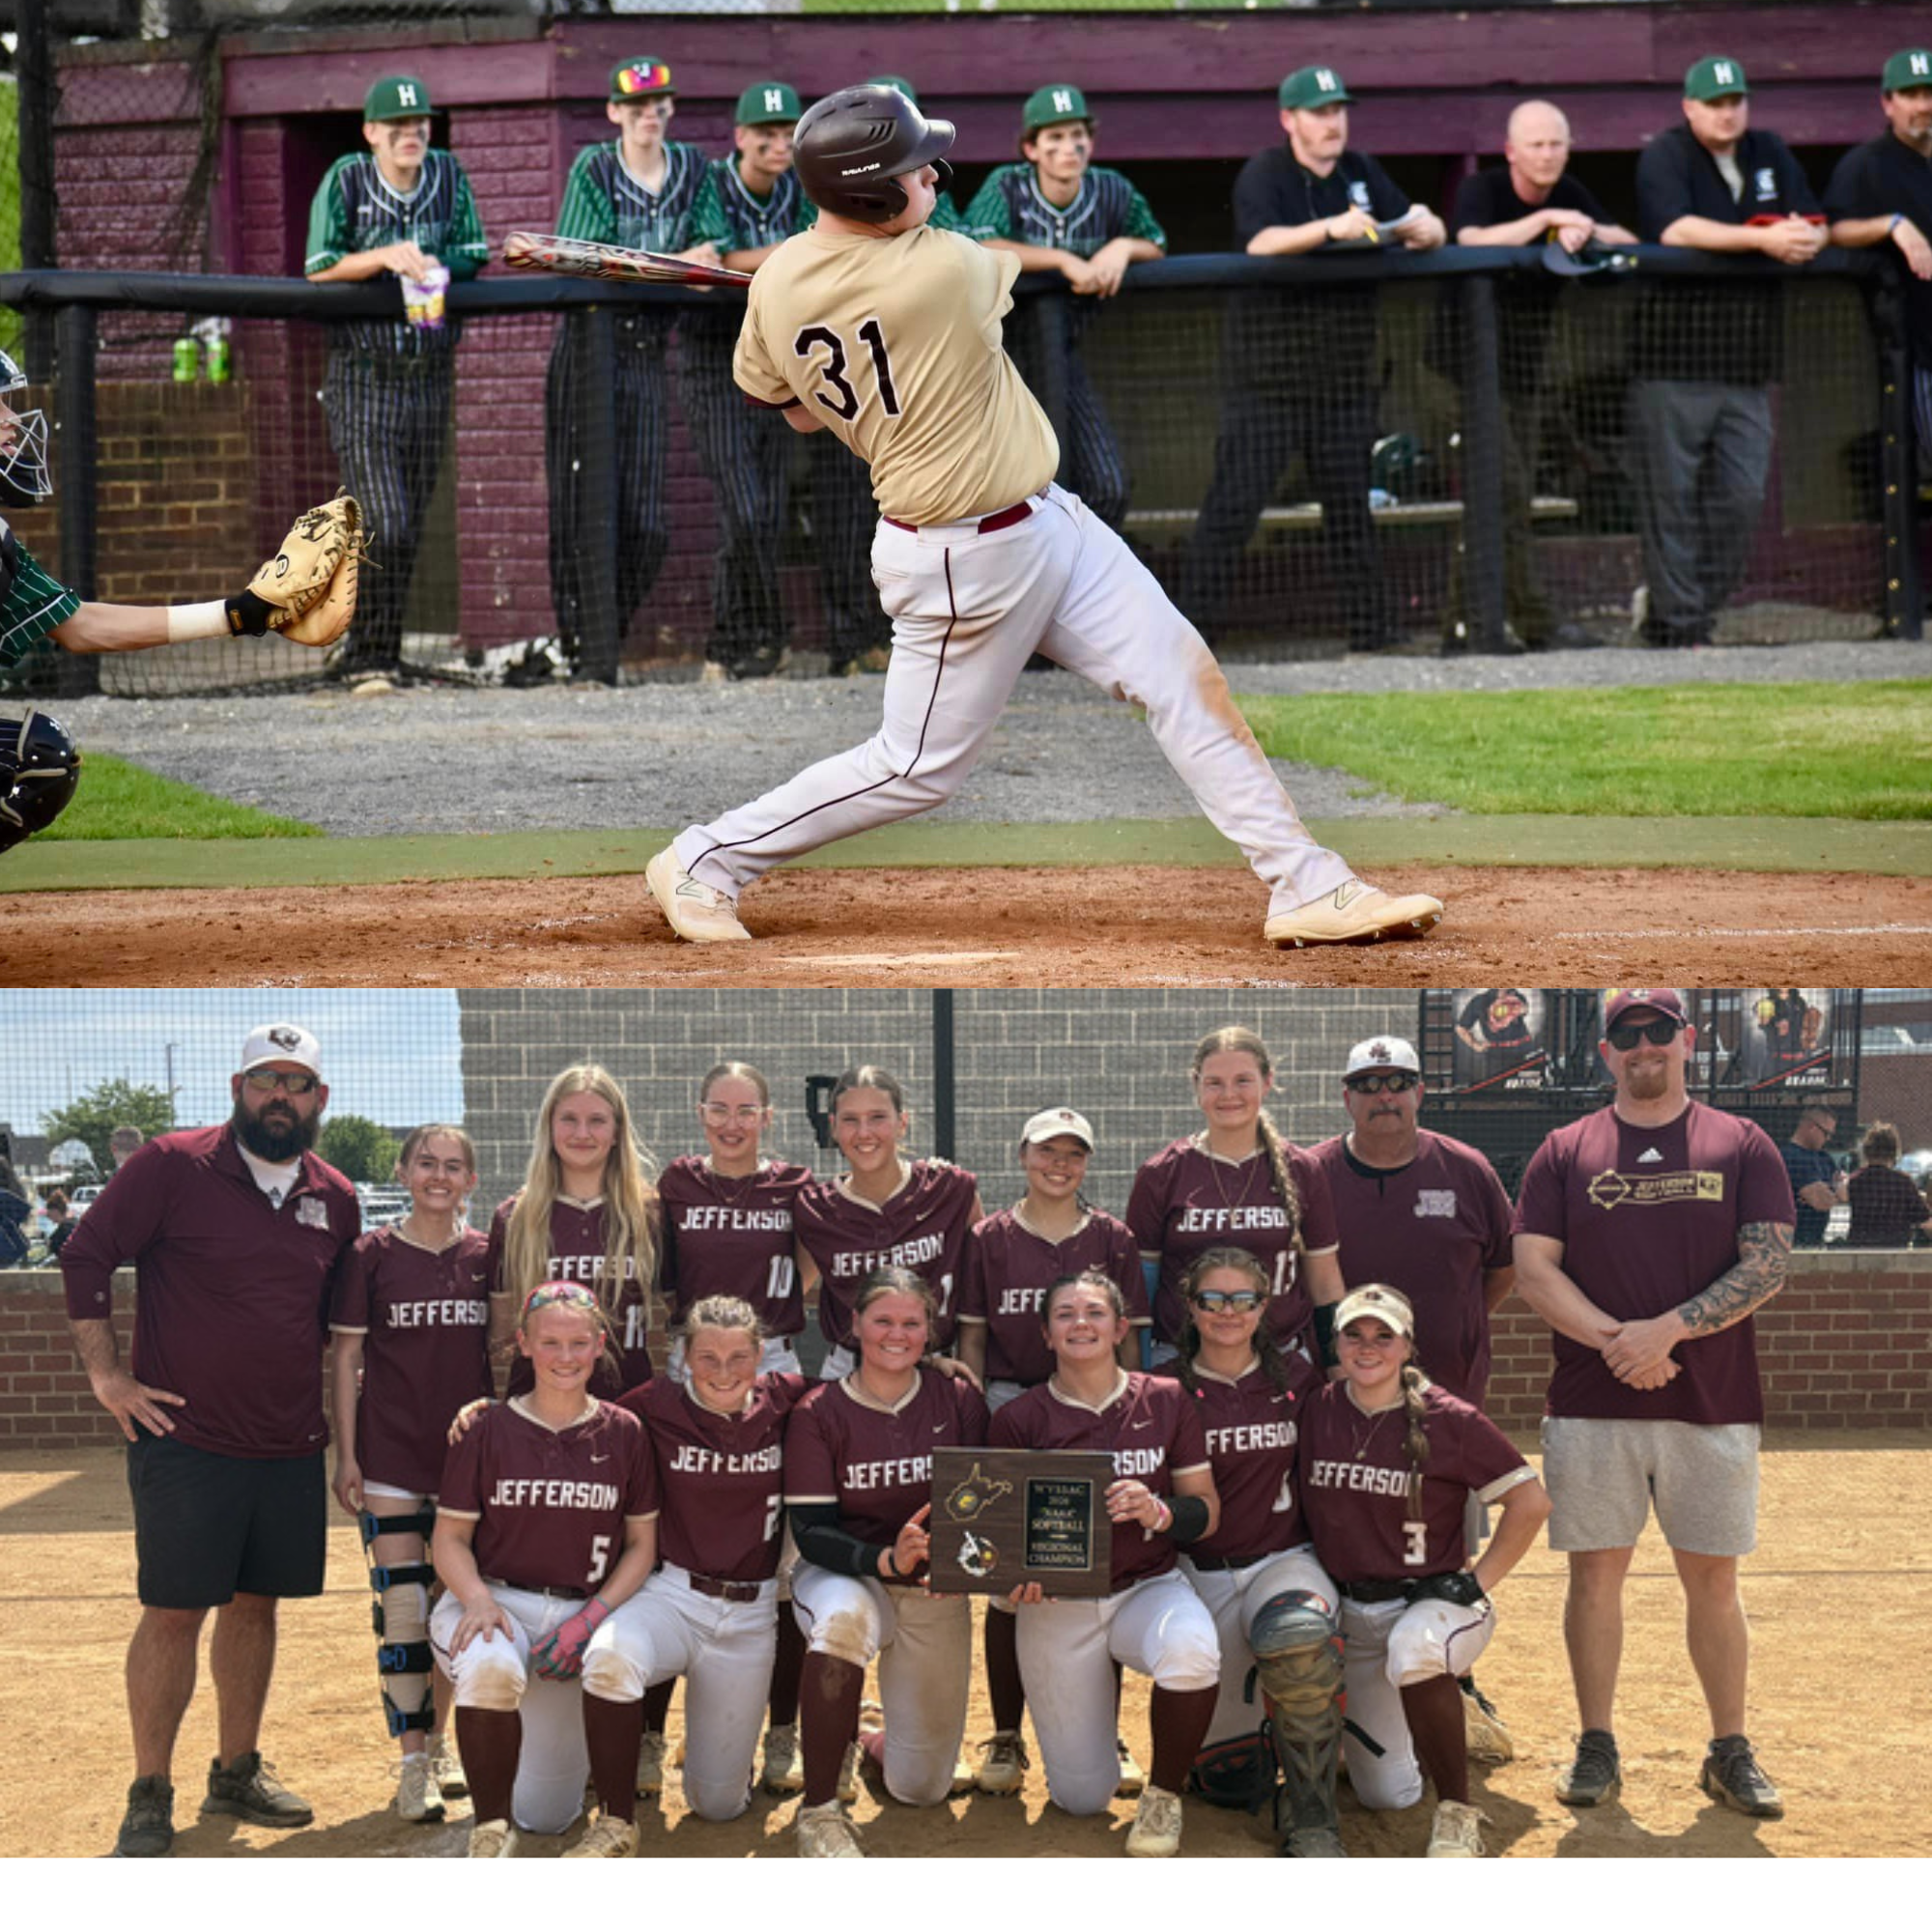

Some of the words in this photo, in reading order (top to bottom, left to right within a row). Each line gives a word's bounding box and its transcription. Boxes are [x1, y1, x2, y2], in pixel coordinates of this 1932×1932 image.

[1714, 62, 1734, 85] H
[1910, 52, 1929, 75] H
[1315, 69, 1337, 92] H
[398, 84, 416, 107] H
[763, 88, 782, 112] H
[1052, 90, 1072, 113] H
[793, 316, 902, 423] 31
[1177, 1207, 1290, 1232] JEFFERSO
[831, 1231, 946, 1277] JEFFERSON
[767, 1255, 794, 1298] 10
[387, 1299, 488, 1328] JEFFERSO
[670, 1445, 781, 1473] JEFFERSO
[490, 1479, 618, 1510] JEFFERSON
[1402, 1521, 1428, 1566] 3
[585, 1535, 612, 1583] 5
